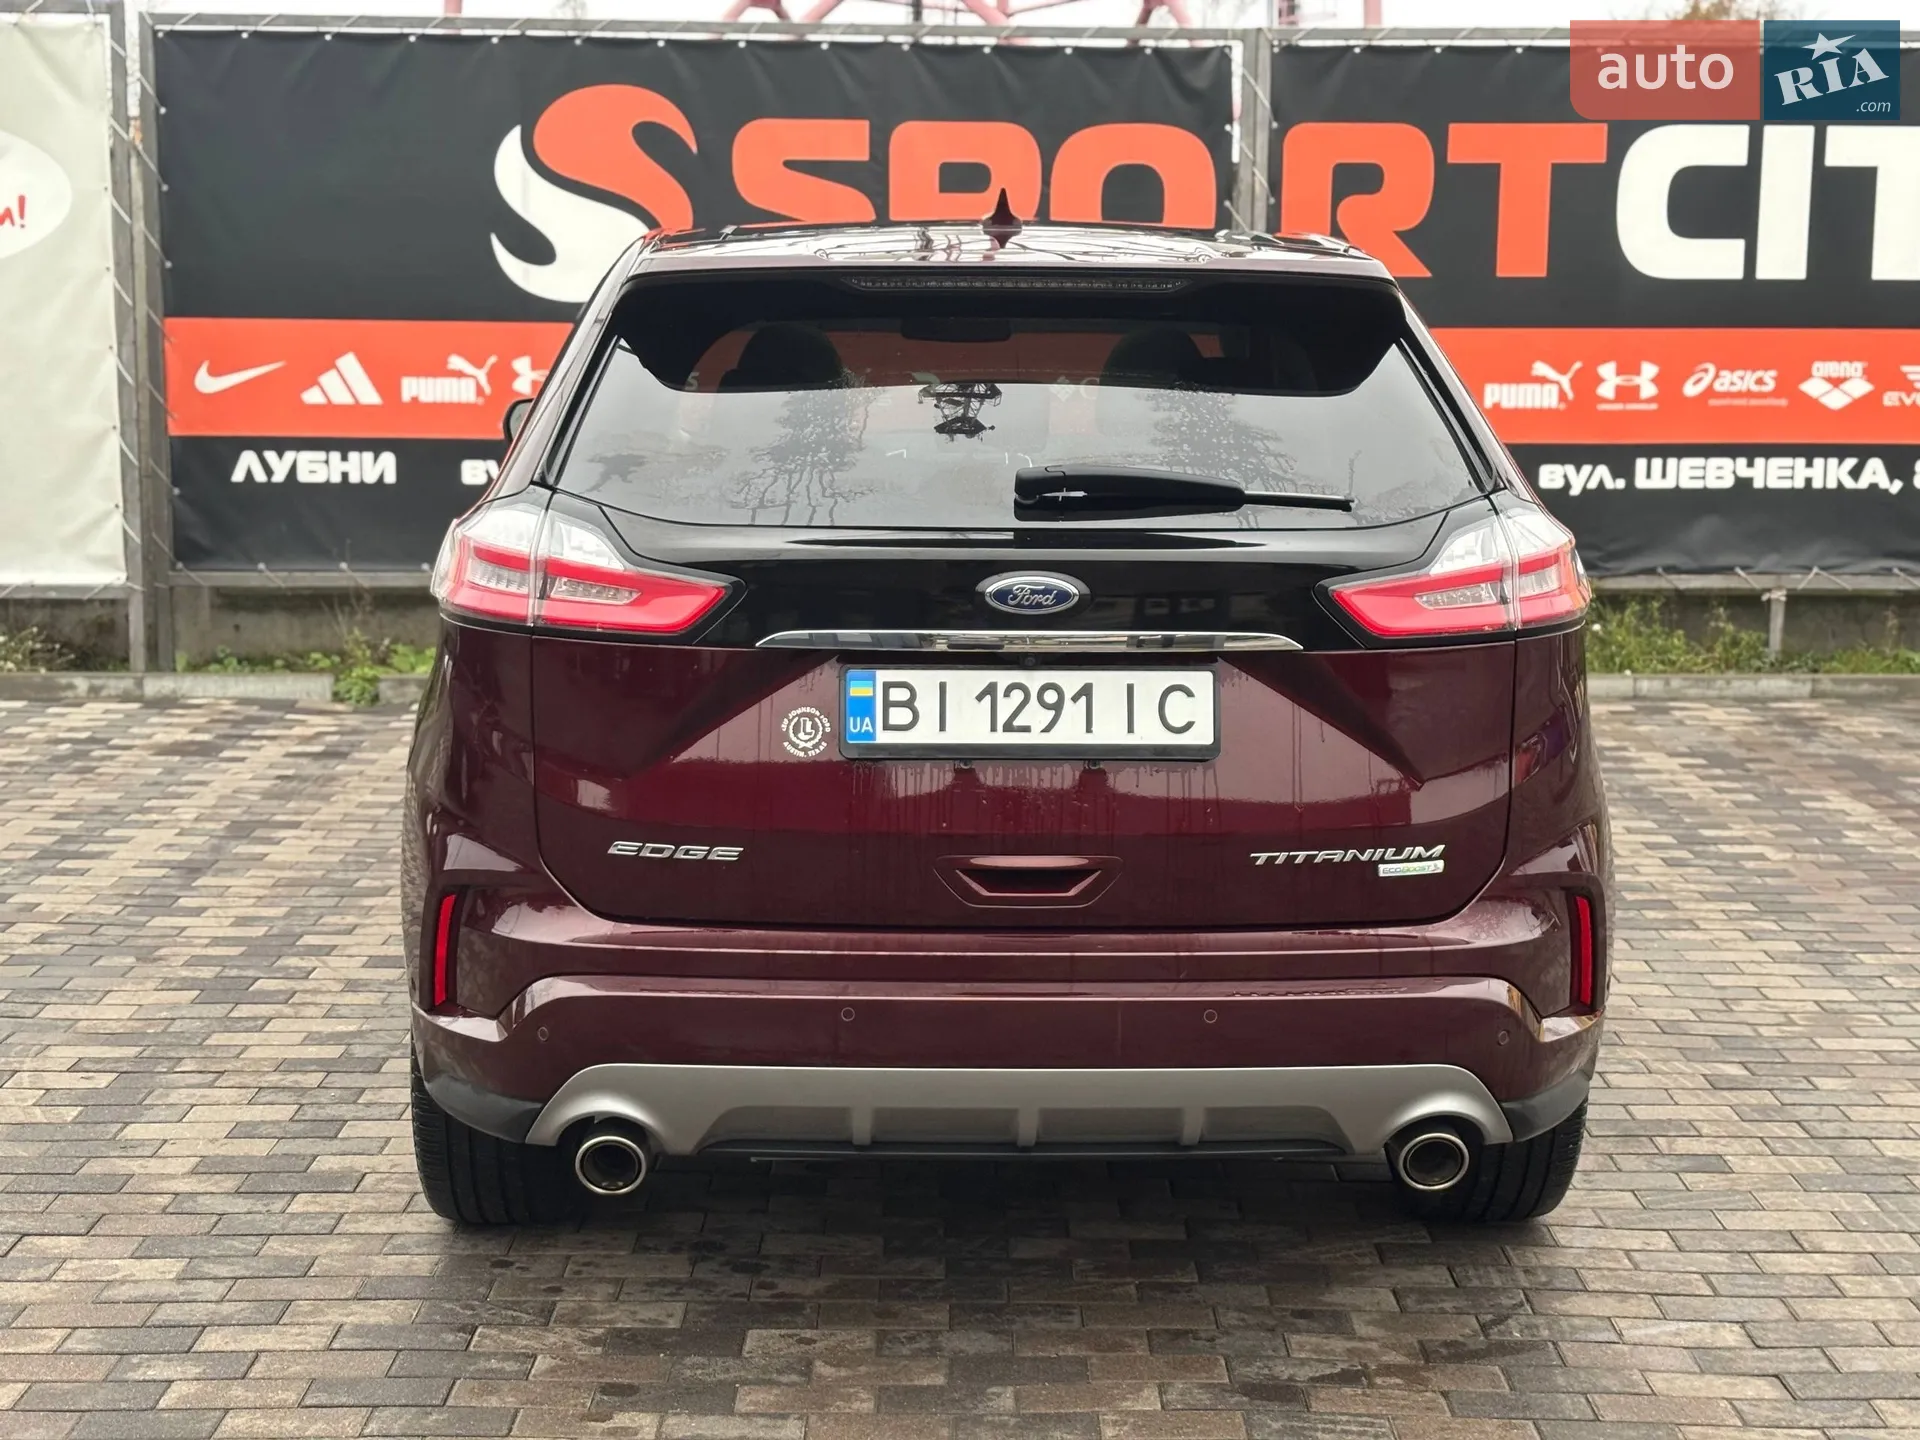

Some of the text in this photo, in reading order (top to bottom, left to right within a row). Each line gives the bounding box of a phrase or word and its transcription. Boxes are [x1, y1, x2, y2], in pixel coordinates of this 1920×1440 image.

[401, 376, 477, 404] PUMA
[1484, 383, 1559, 409] PUMA
[231, 450, 397, 485] ЛУБНИ
[1538, 463, 1626, 495] вул.
[1634, 457, 1904, 494] ШЕВЧЕНКА,
[1007, 583, 1059, 608] Ford
[975, 681, 1094, 734] 1291
[849, 716, 874, 734] UA
[607, 840, 745, 862] EDGE
[1250, 844, 1446, 866] TITANIUM
